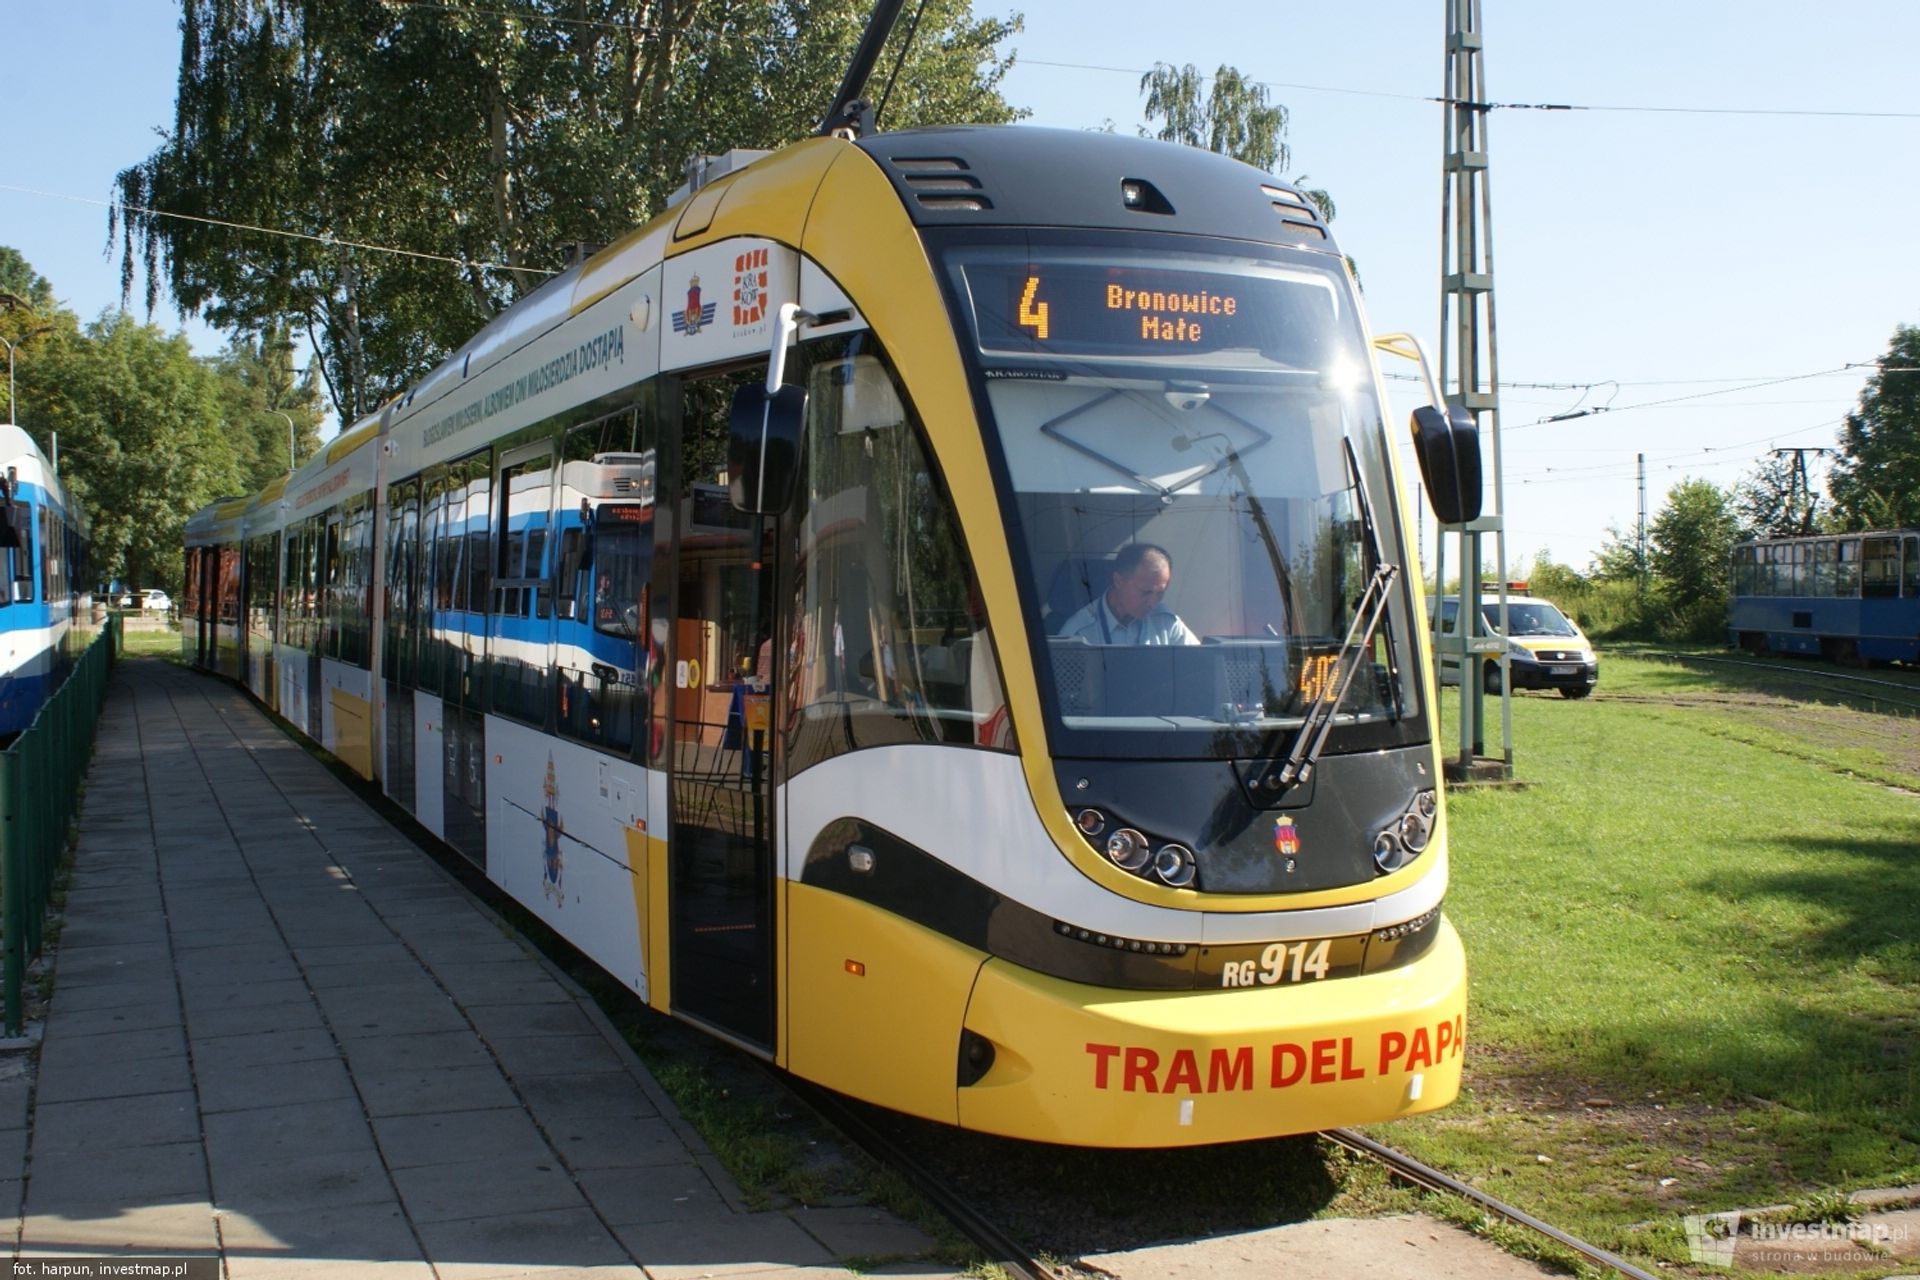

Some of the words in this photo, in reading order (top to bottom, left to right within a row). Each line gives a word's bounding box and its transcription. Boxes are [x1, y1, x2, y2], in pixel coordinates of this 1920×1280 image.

[1019, 277, 1049, 339] 4
[1107, 284, 1237, 315] Bronowice
[1141, 315, 1202, 341] Małe
[579, 325, 624, 374] DOSTĄPIĄ
[1086, 1042, 1255, 1095] TRAM
[1270, 1039, 1365, 1089] DEL
[1378, 1014, 1463, 1076] PAPA
